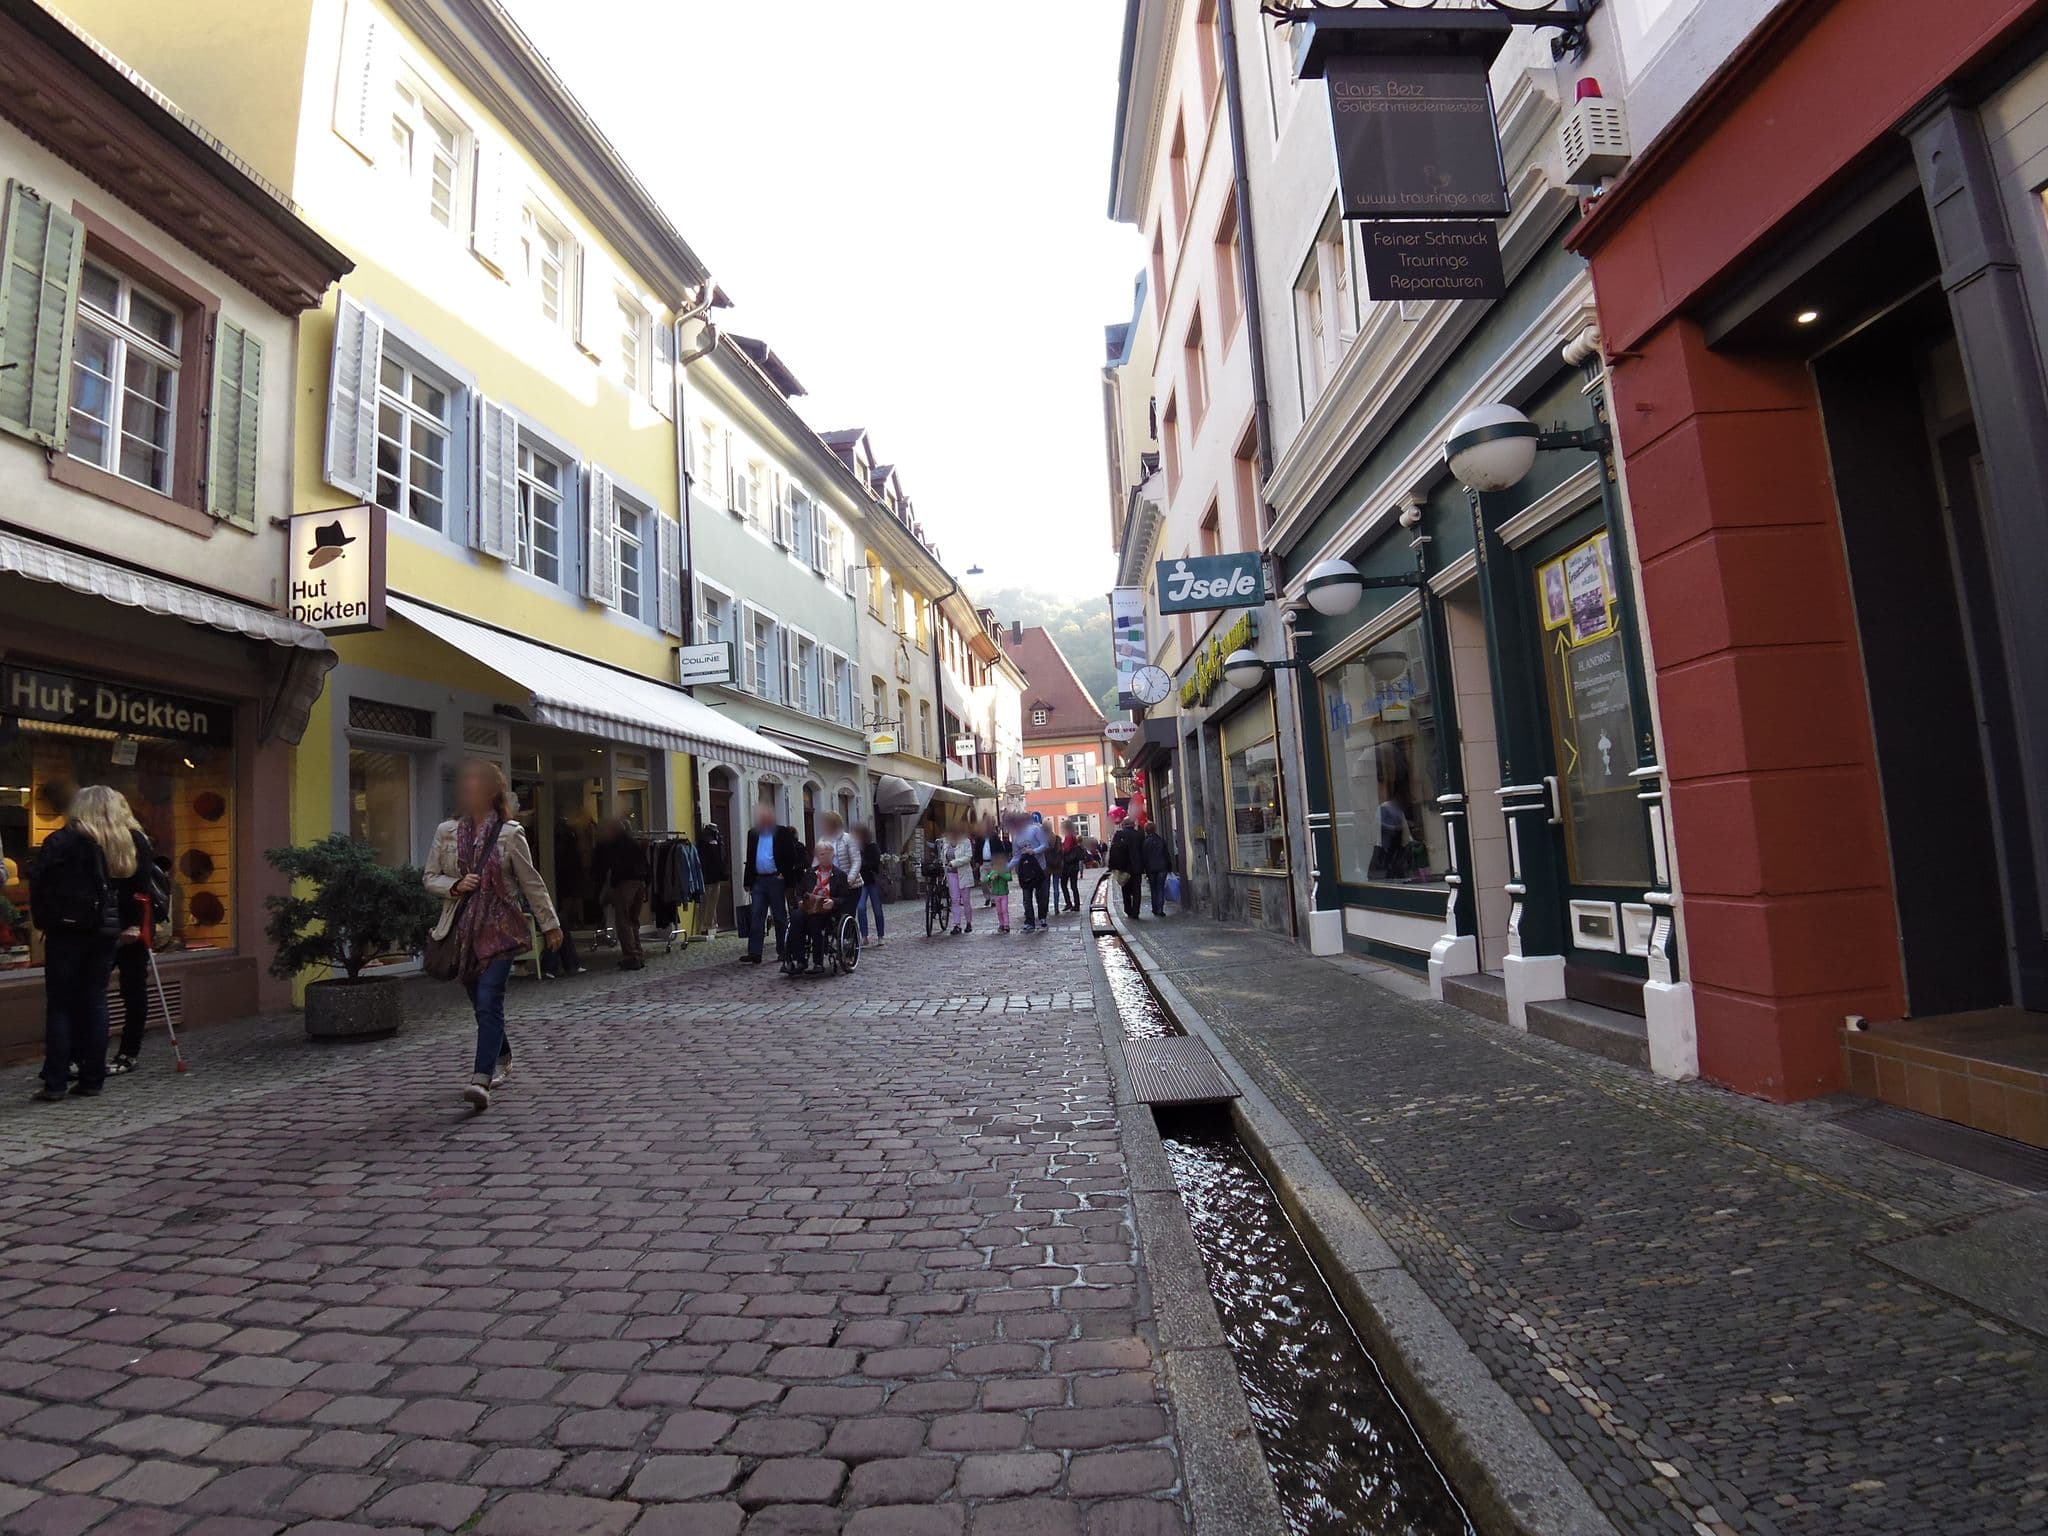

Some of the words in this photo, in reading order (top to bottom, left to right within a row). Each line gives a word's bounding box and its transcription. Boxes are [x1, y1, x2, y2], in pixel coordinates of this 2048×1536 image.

[1334, 81, 1381, 97] Claus
[1387, 81, 1425, 97] Betz
[1336, 100, 1485, 113] Goldschmiedemeister
[1374, 231, 1420, 246] Feiner
[1425, 231, 1488, 246] Schmuck
[1399, 253, 1469, 270] Trauringe
[1390, 274, 1484, 291] Reparaturen
[292, 578, 327, 600] Hut
[292, 597, 367, 624] Dickten
